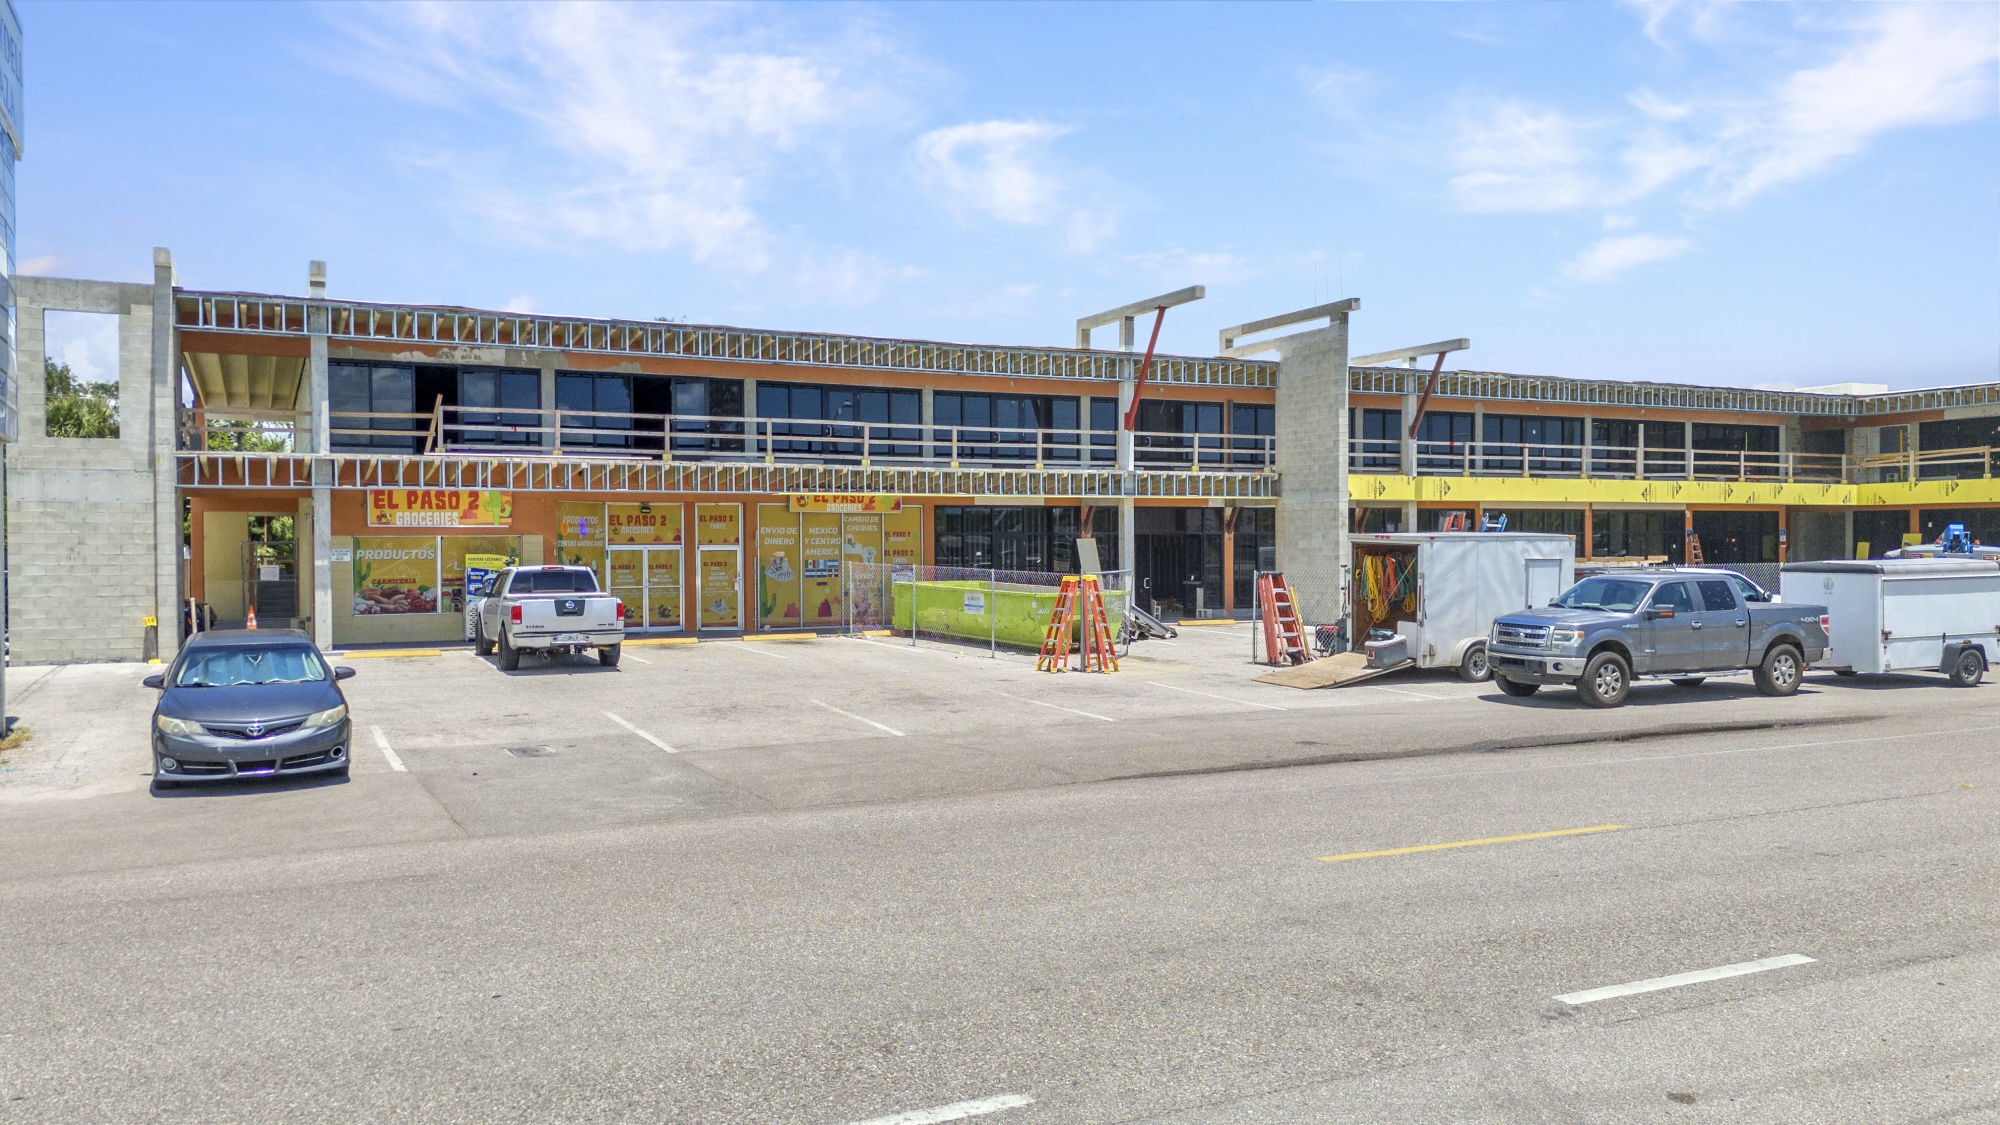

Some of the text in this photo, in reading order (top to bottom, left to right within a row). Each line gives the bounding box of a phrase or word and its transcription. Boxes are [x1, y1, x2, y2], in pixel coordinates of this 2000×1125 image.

[373, 490, 479, 510] EL PASO 2
[396, 511, 459, 525] GROCERIES
[609, 514, 667, 526] EL PASO 2
[356, 549, 435, 560] PRODUCTOS
